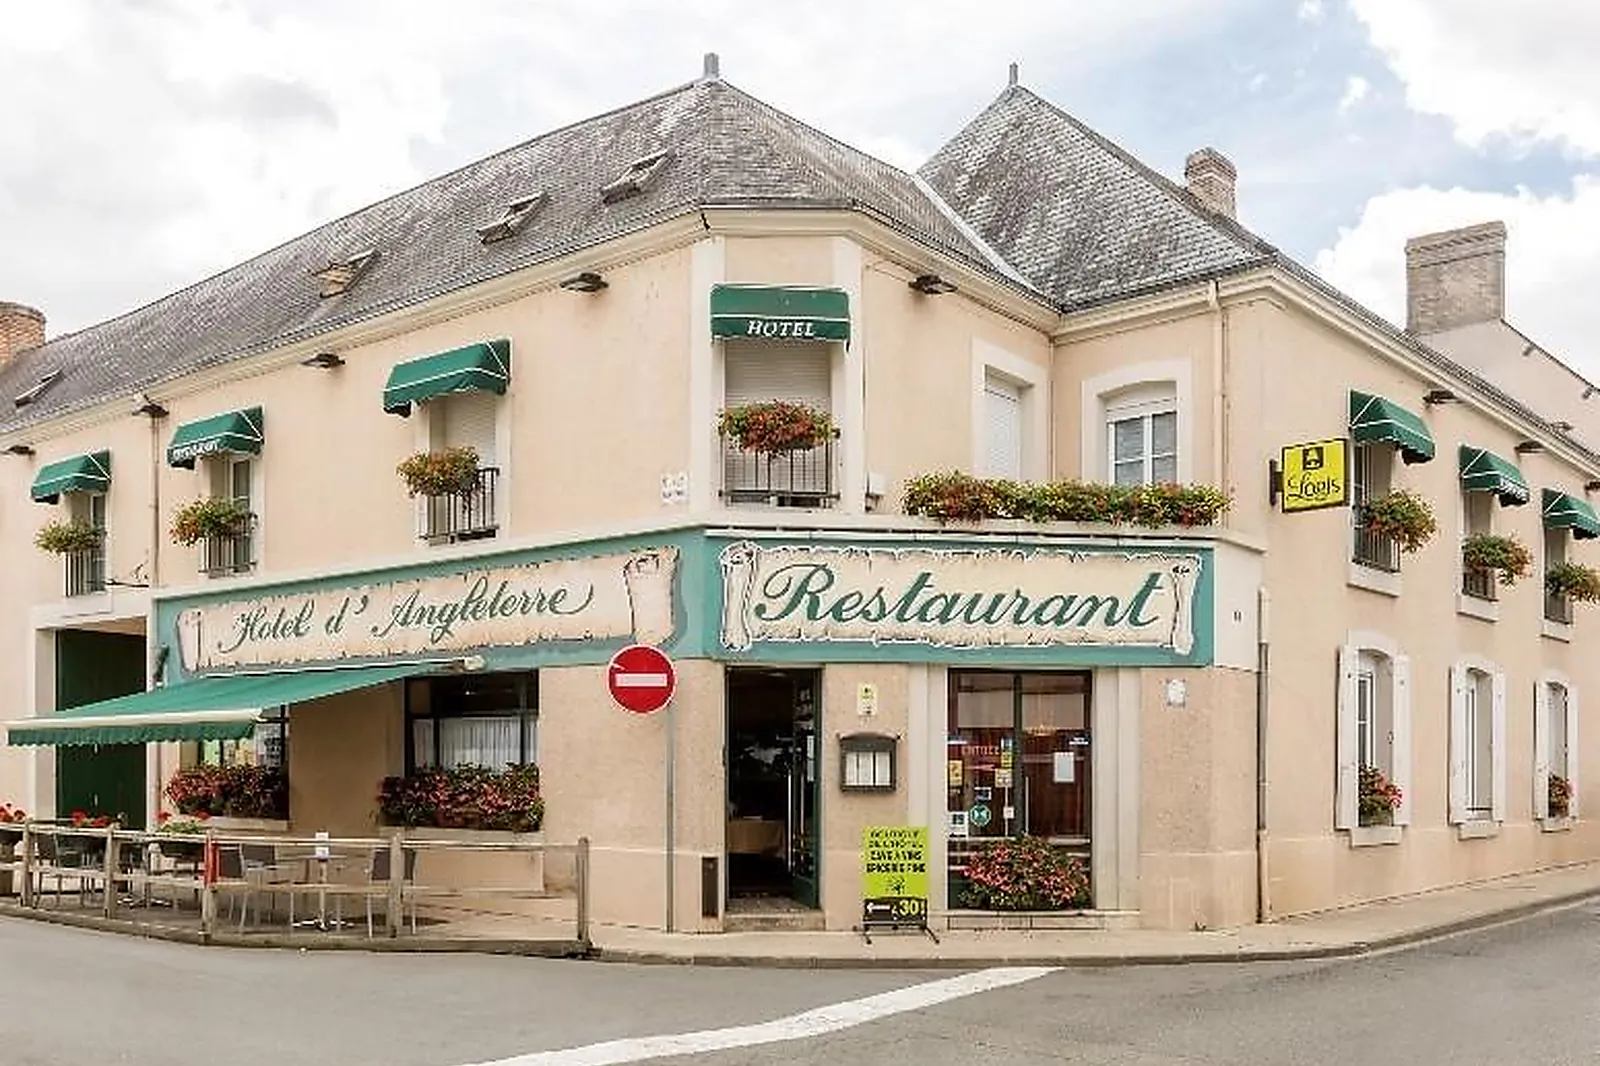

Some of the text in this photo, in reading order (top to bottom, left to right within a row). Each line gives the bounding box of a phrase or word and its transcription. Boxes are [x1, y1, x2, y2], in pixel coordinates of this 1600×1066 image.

[747, 319, 816, 337] HOTEL
[217, 597, 314, 654] Hotel
[371, 576, 594, 644] Angleterre
[754, 562, 1163, 628] Restaurant
